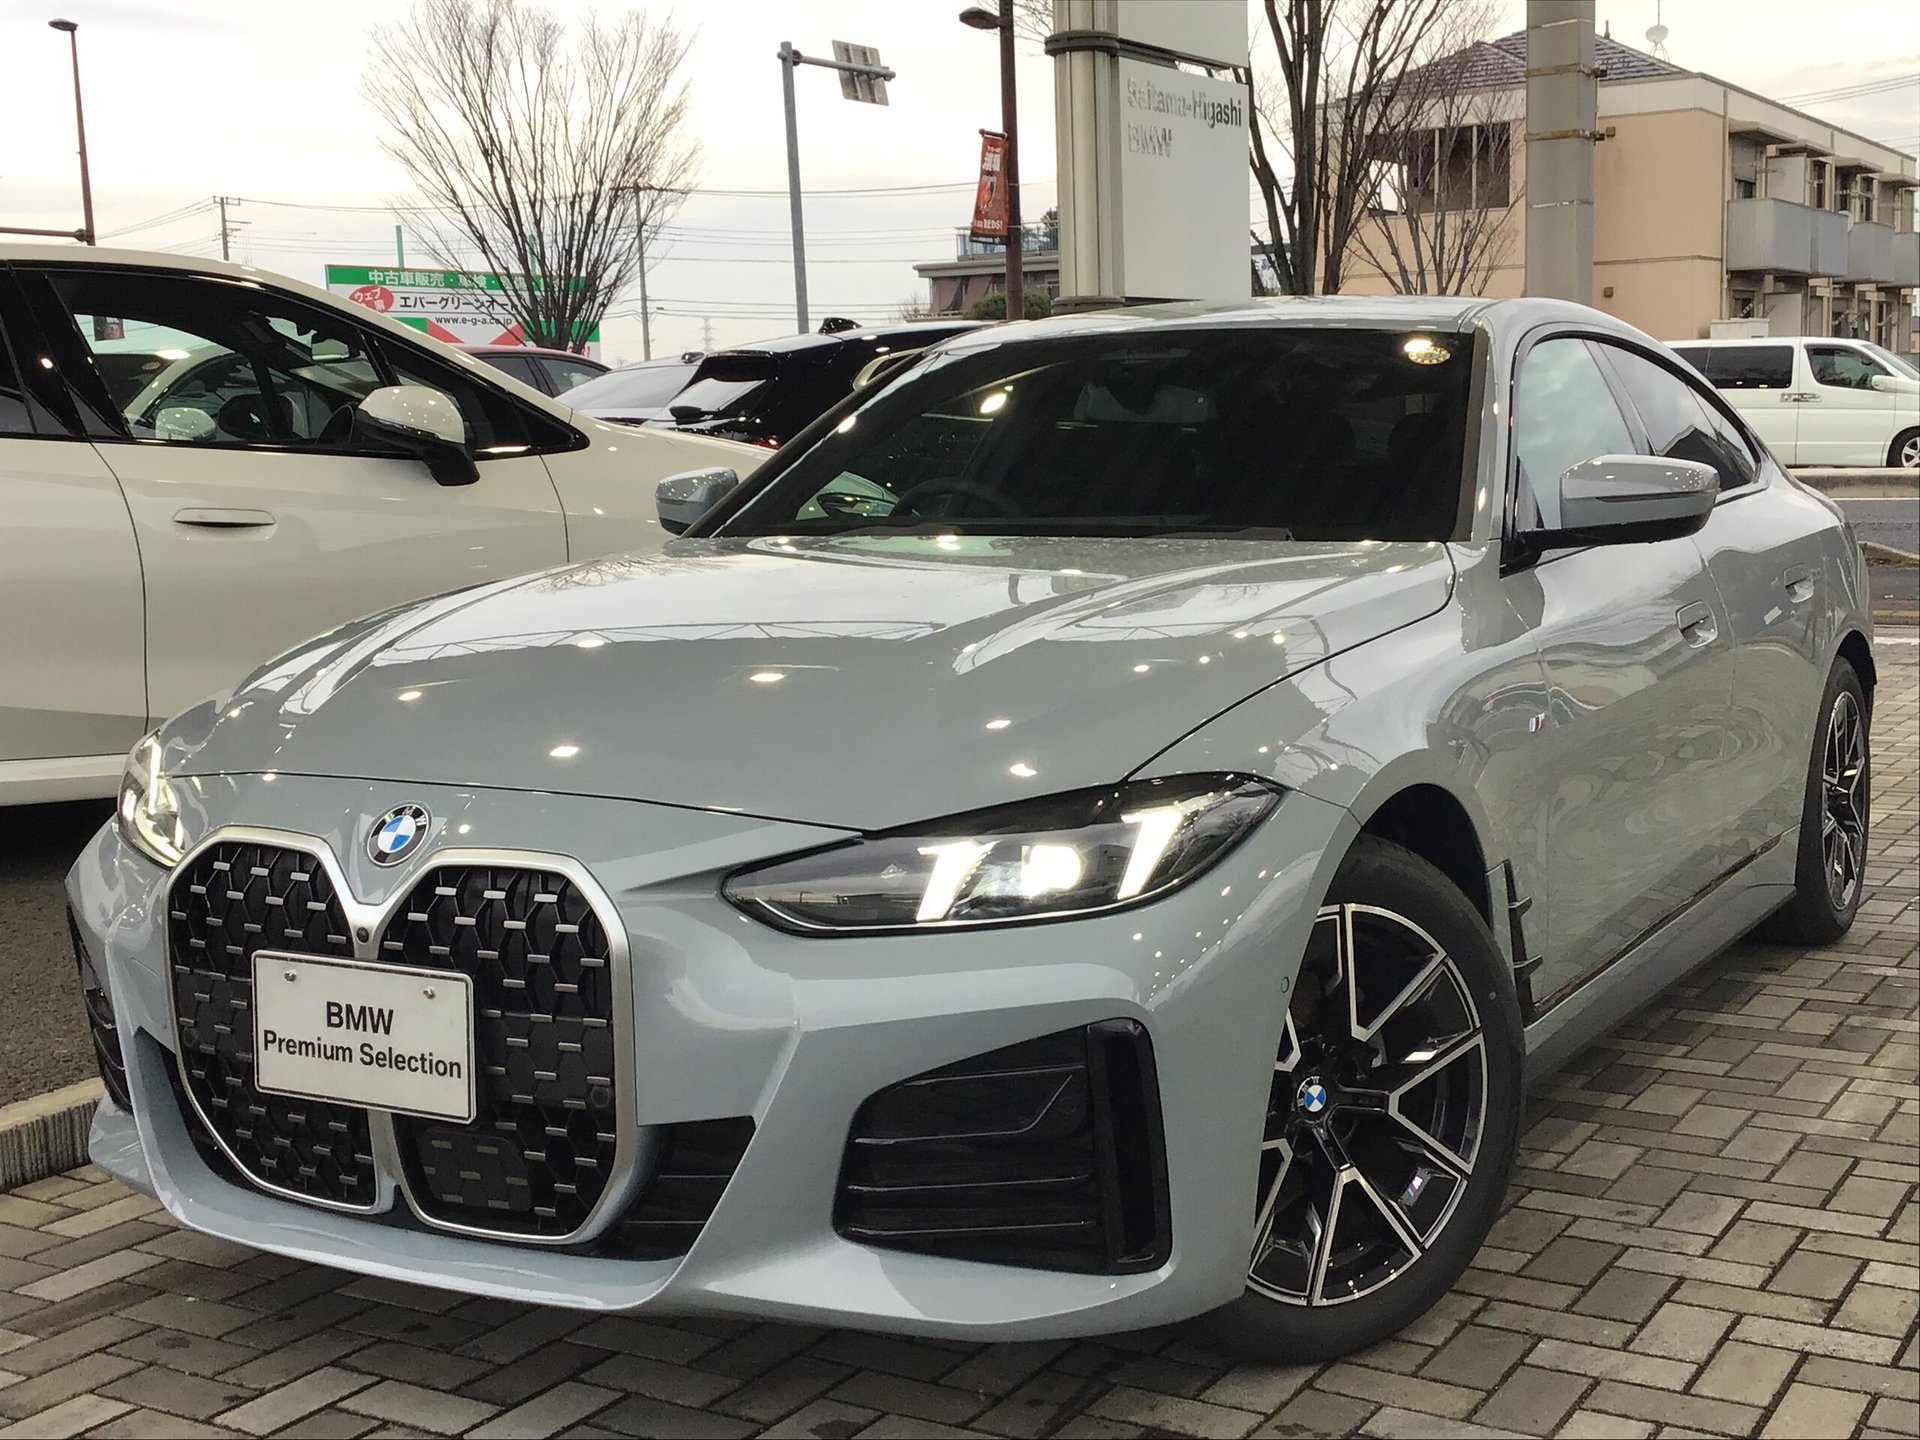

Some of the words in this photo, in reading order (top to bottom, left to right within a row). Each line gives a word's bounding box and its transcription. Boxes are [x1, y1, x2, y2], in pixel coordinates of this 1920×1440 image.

[1127, 78, 1242, 128] Saitama-Higashi
[1127, 122, 1172, 158] BMW
[325, 1001, 394, 1035] BMW
[263, 1029, 353, 1063] Premium
[359, 1043, 462, 1079] Selection
